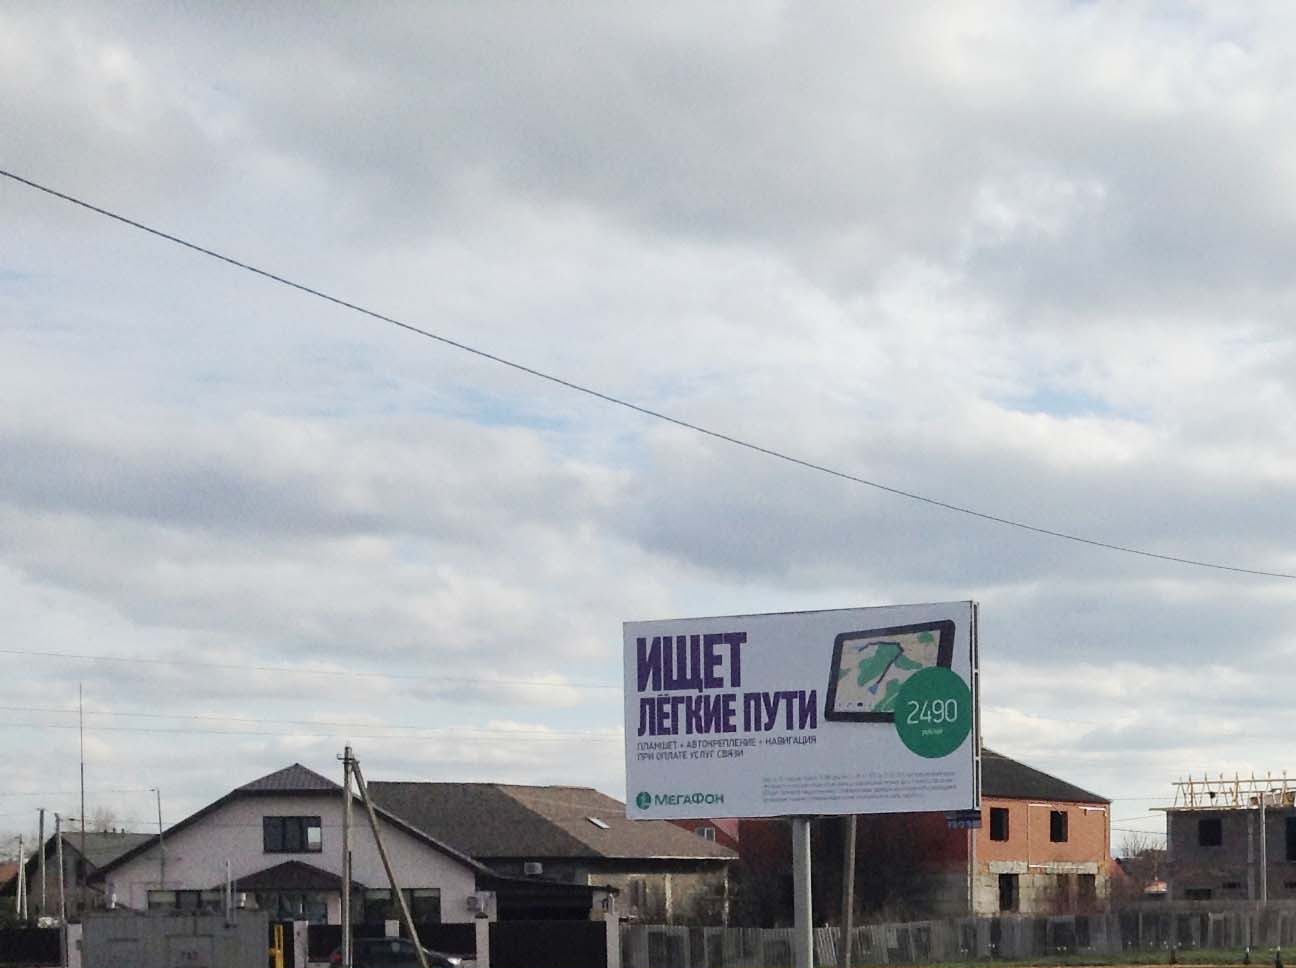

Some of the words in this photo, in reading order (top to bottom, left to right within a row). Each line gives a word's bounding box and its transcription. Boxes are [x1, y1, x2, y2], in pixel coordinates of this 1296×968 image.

[636, 631, 748, 693] ИЩЕТ
[637, 693, 737, 737] ЛЁГКИЕ
[743, 689, 818, 733] ПУТИ
[906, 698, 958, 725] 2490
[765, 735, 817, 747] НАВИГАЦИЯ
[637, 751, 655, 761] ПРИ
[656, 750, 688, 761] ОПЛАТЕ
[689, 749, 714, 760] УСЛУГ
